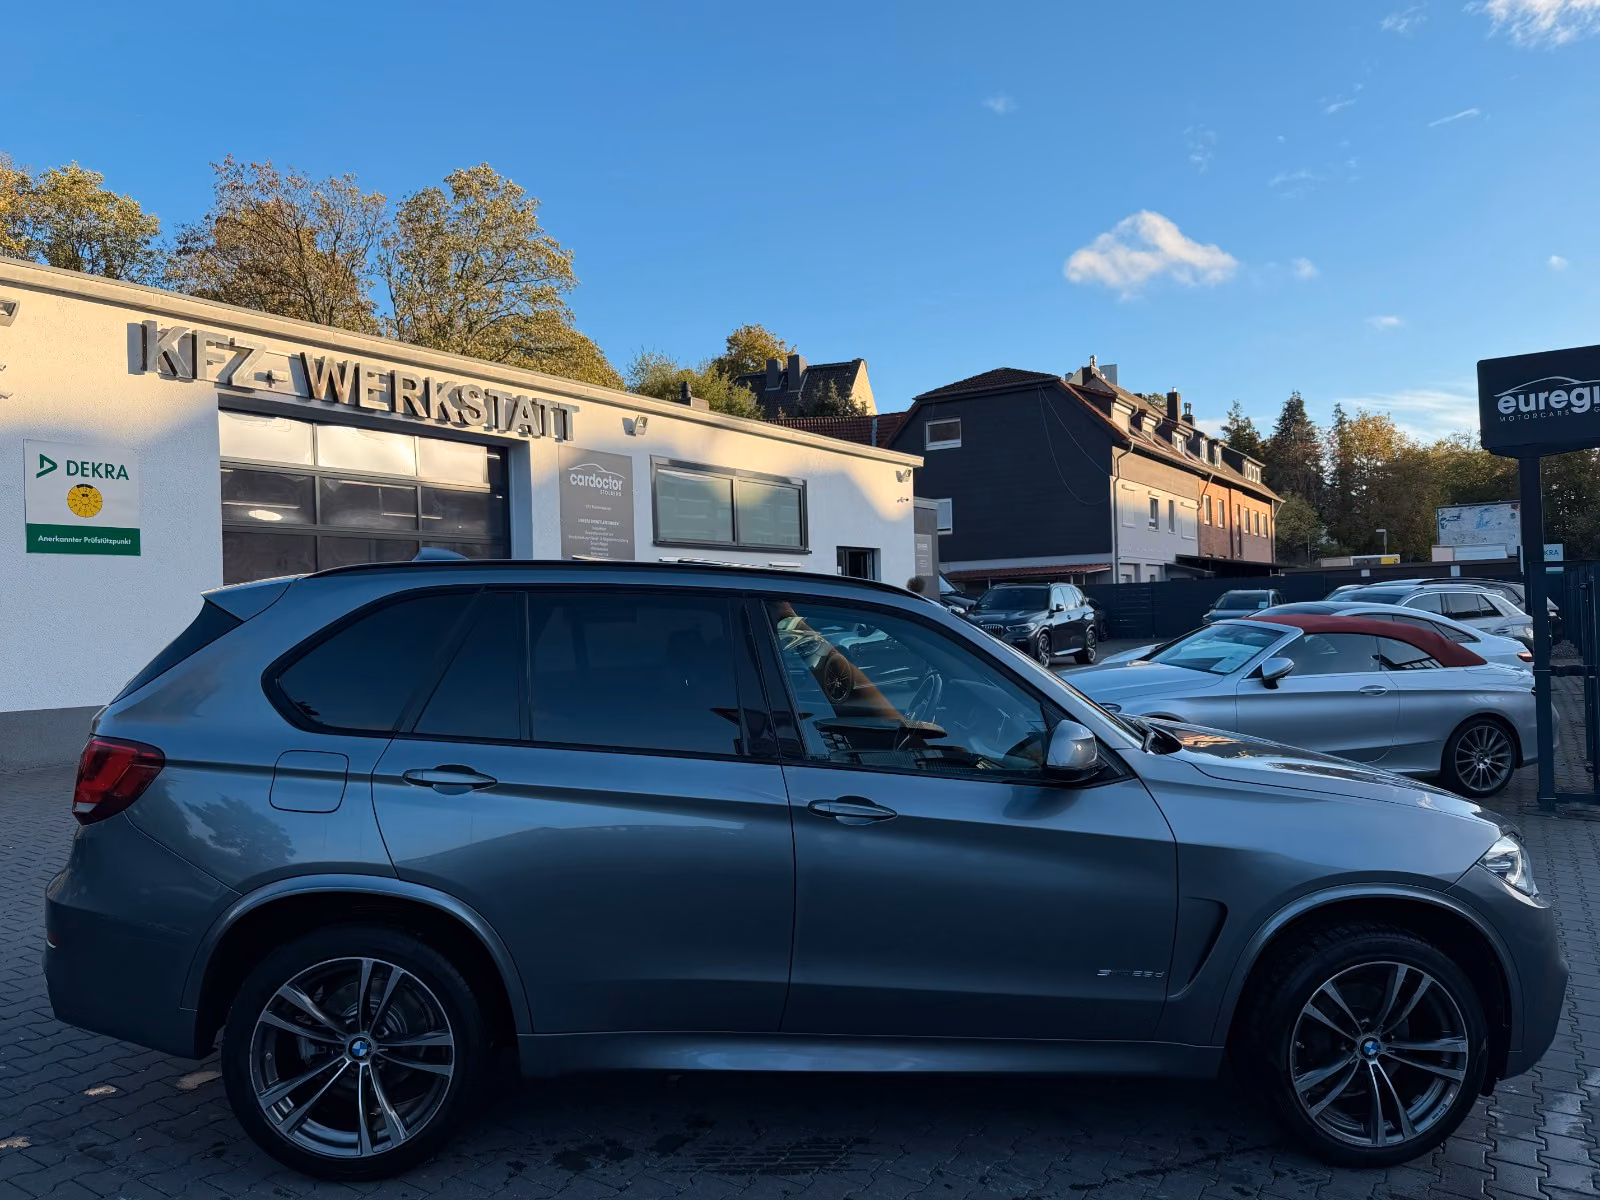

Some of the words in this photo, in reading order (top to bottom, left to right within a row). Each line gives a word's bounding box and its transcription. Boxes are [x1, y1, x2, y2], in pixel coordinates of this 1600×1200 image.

[1499, 409, 1570, 422] MOTORCARS
[66, 459, 130, 480] DEKRA
[569, 473, 623, 491] cardoctor
[38, 535, 82, 543] Anerkannter
[84, 536, 131, 545] Prüfstützpunkt
